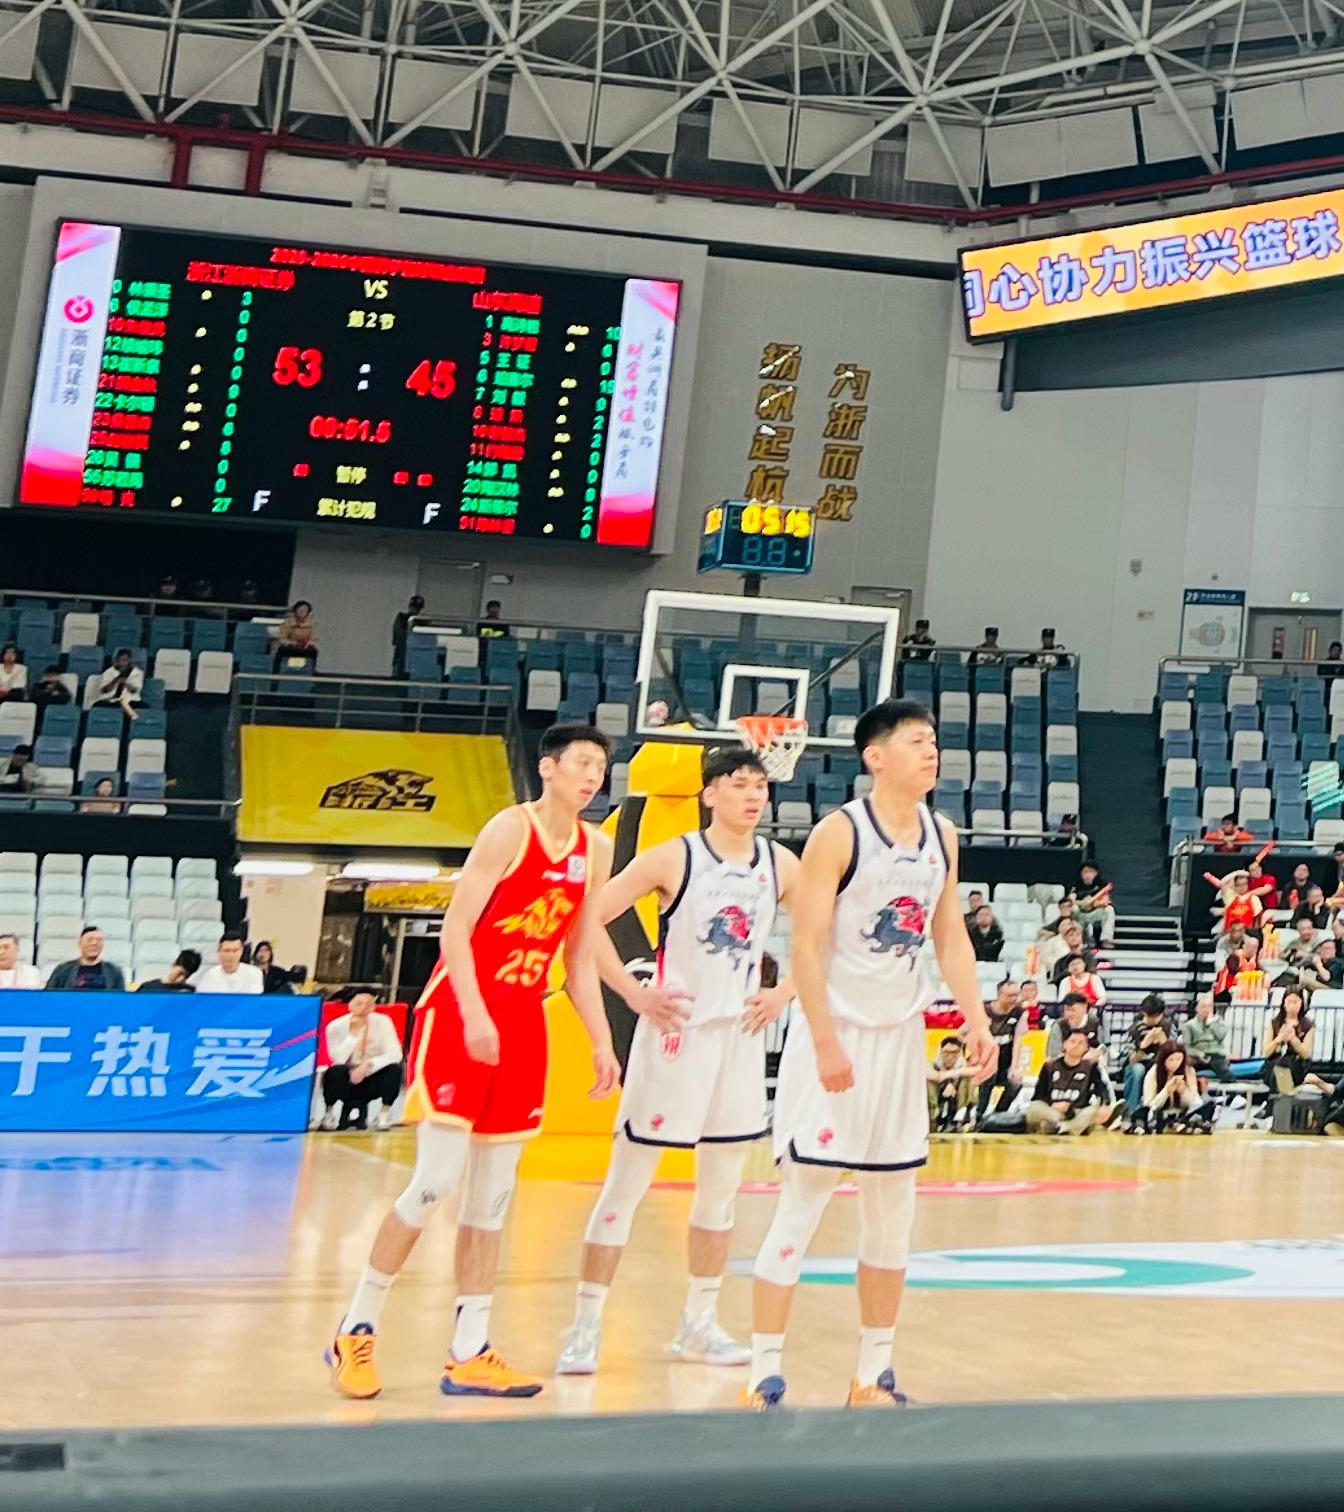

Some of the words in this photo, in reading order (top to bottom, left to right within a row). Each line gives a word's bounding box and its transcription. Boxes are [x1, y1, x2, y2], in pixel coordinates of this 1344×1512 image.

[363, 278, 389, 299] VS
[272, 346, 323, 388] 53
[405, 359, 457, 399] 45
[744, 342, 802, 506] 扬帆起杭
[814, 363, 872, 522] 为浙而战
[252, 489, 271, 512] F
[423, 502, 441, 525] F
[494, 948, 550, 987] 25
[0, 1025, 273, 1098] 于热爱
